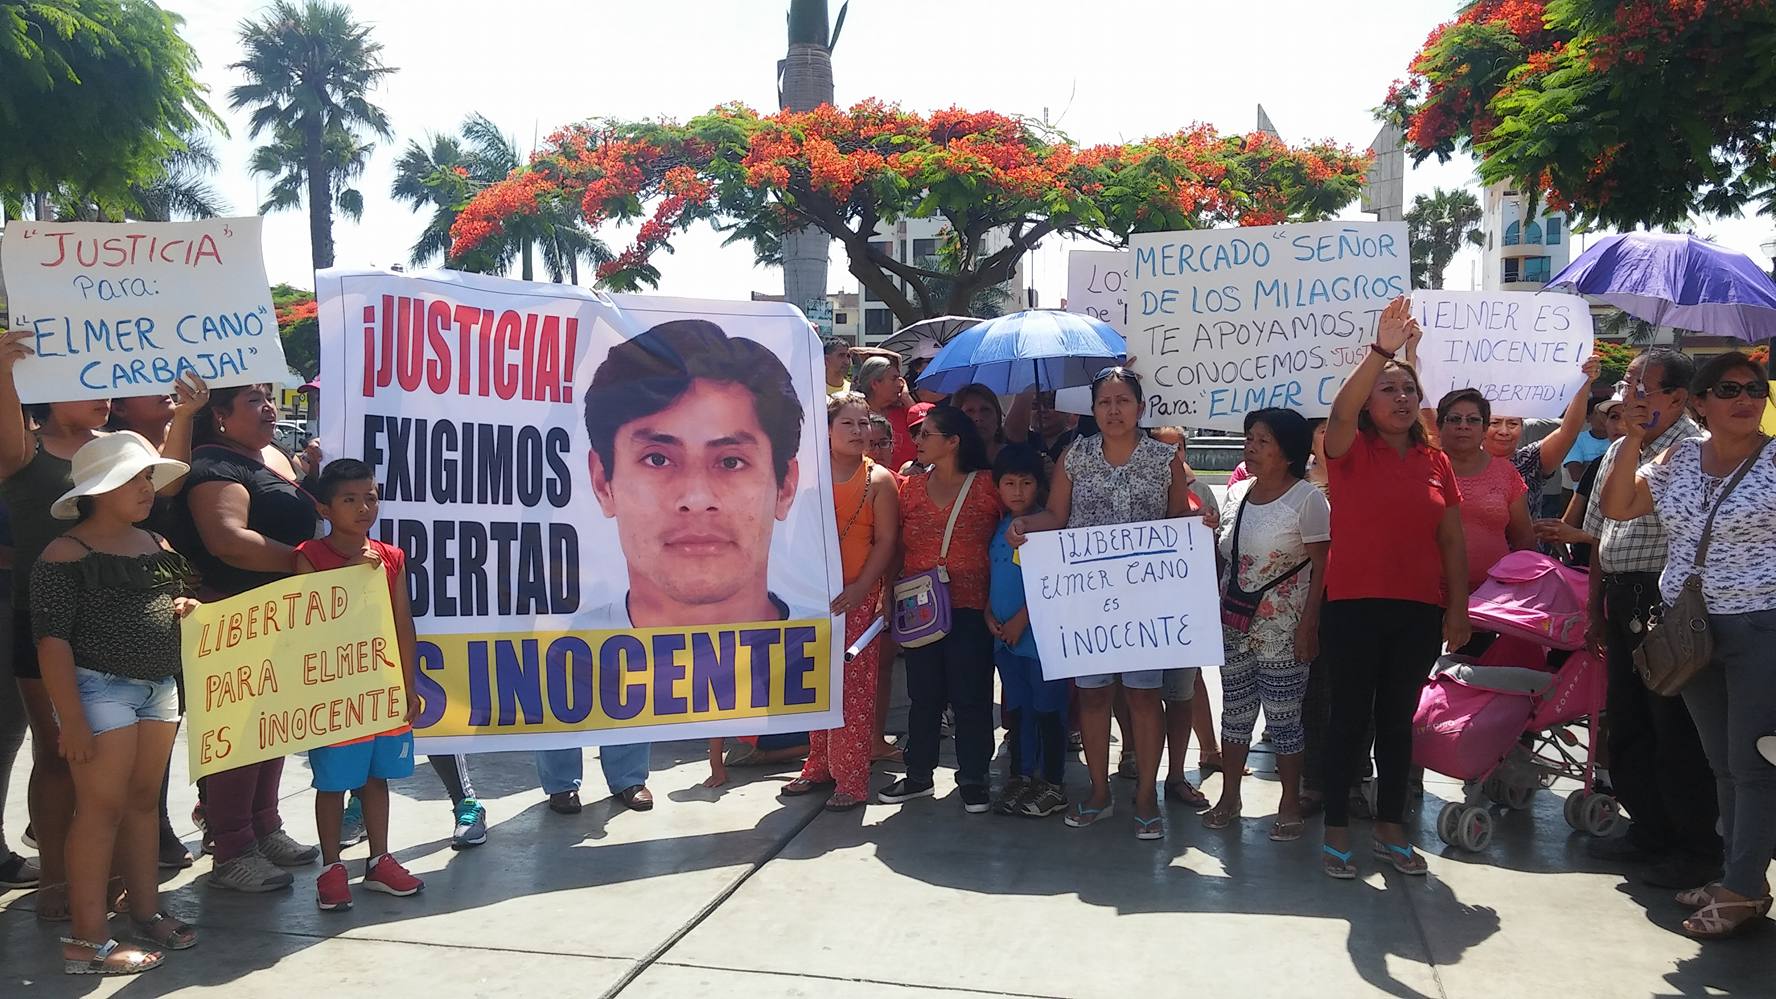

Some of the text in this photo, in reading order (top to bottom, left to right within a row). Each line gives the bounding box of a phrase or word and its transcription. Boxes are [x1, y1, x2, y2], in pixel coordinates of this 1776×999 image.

[1134, 238, 1270, 280] MERCADO
[73, 274, 160, 301] Para:
[1141, 289, 1181, 317] DE
[1192, 285, 1241, 314] LOS
[1253, 274, 1405, 311] MILAGROS
[1143, 324, 1181, 356] TE
[1192, 310, 1365, 353] APOYAMOS,
[1422, 301, 1570, 332] ¡ELMER ES
[363, 294, 578, 404] ¡JUSTICIA!
[1149, 394, 1197, 418] Para:
[363, 414, 572, 508] EXIGIMOS
[1126, 558, 1189, 585] CANO
[1103, 598, 1120, 612] ES
[206, 637, 396, 712] PARA ELMER
[468, 626, 817, 728] INOCENTE
[200, 726, 232, 765] ES
